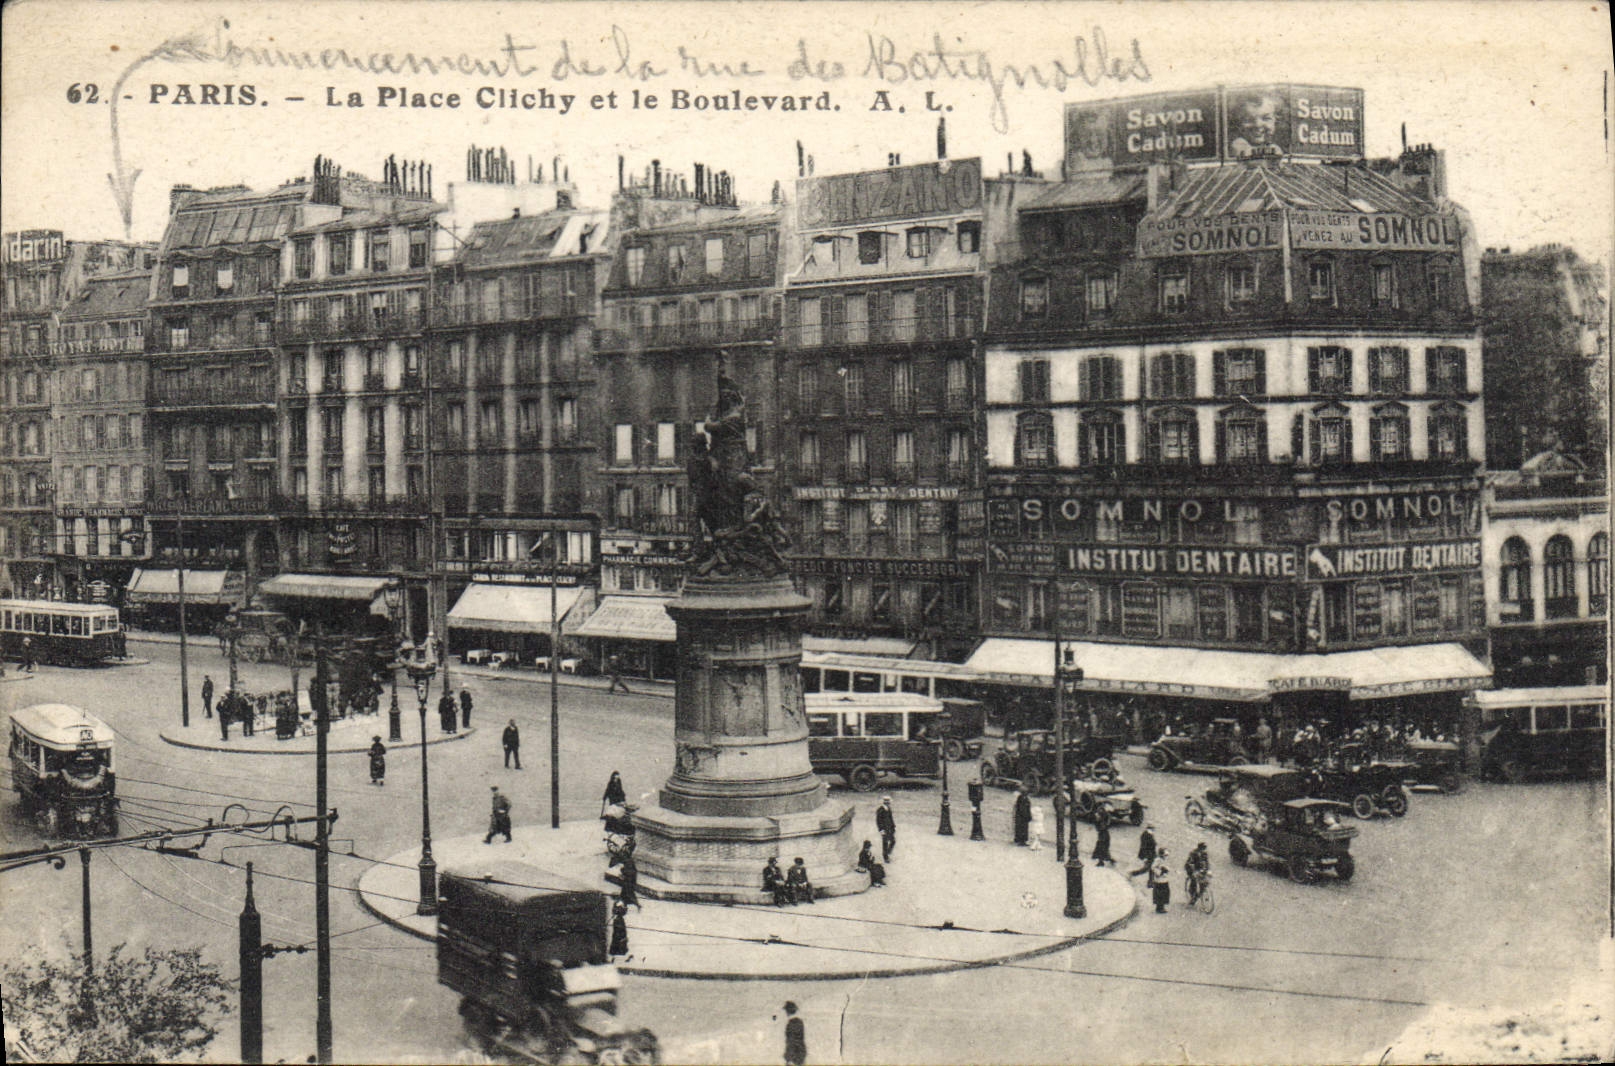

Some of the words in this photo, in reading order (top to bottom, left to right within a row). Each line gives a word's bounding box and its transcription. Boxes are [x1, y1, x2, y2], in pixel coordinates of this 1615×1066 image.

[552, 39, 606, 81] de
[612, 24, 668, 81] la
[678, 46, 765, 77] rue
[788, 38, 845, 82] des
[862, 25, 1151, 134] Batignolles
[1126, 107, 1204, 130] Savon
[1297, 98, 1355, 121] Savon
[1127, 133, 1204, 153] Cadum
[1298, 123, 1356, 146] Cadum
[801, 161, 978, 225] CINZANO
[1173, 225, 1279, 251] SOMNOL
[1358, 215, 1457, 246] SOMNOL
[1023, 499, 1243, 522] SOMNOL
[1327, 494, 1465, 522] SOMNOL
[1069, 548, 1168, 572] INSTITUT
[1176, 550, 1297, 577] DENTAIRE
[1337, 546, 1406, 573] INSTITUT
[1412, 542, 1481, 570] DENTAIRE
